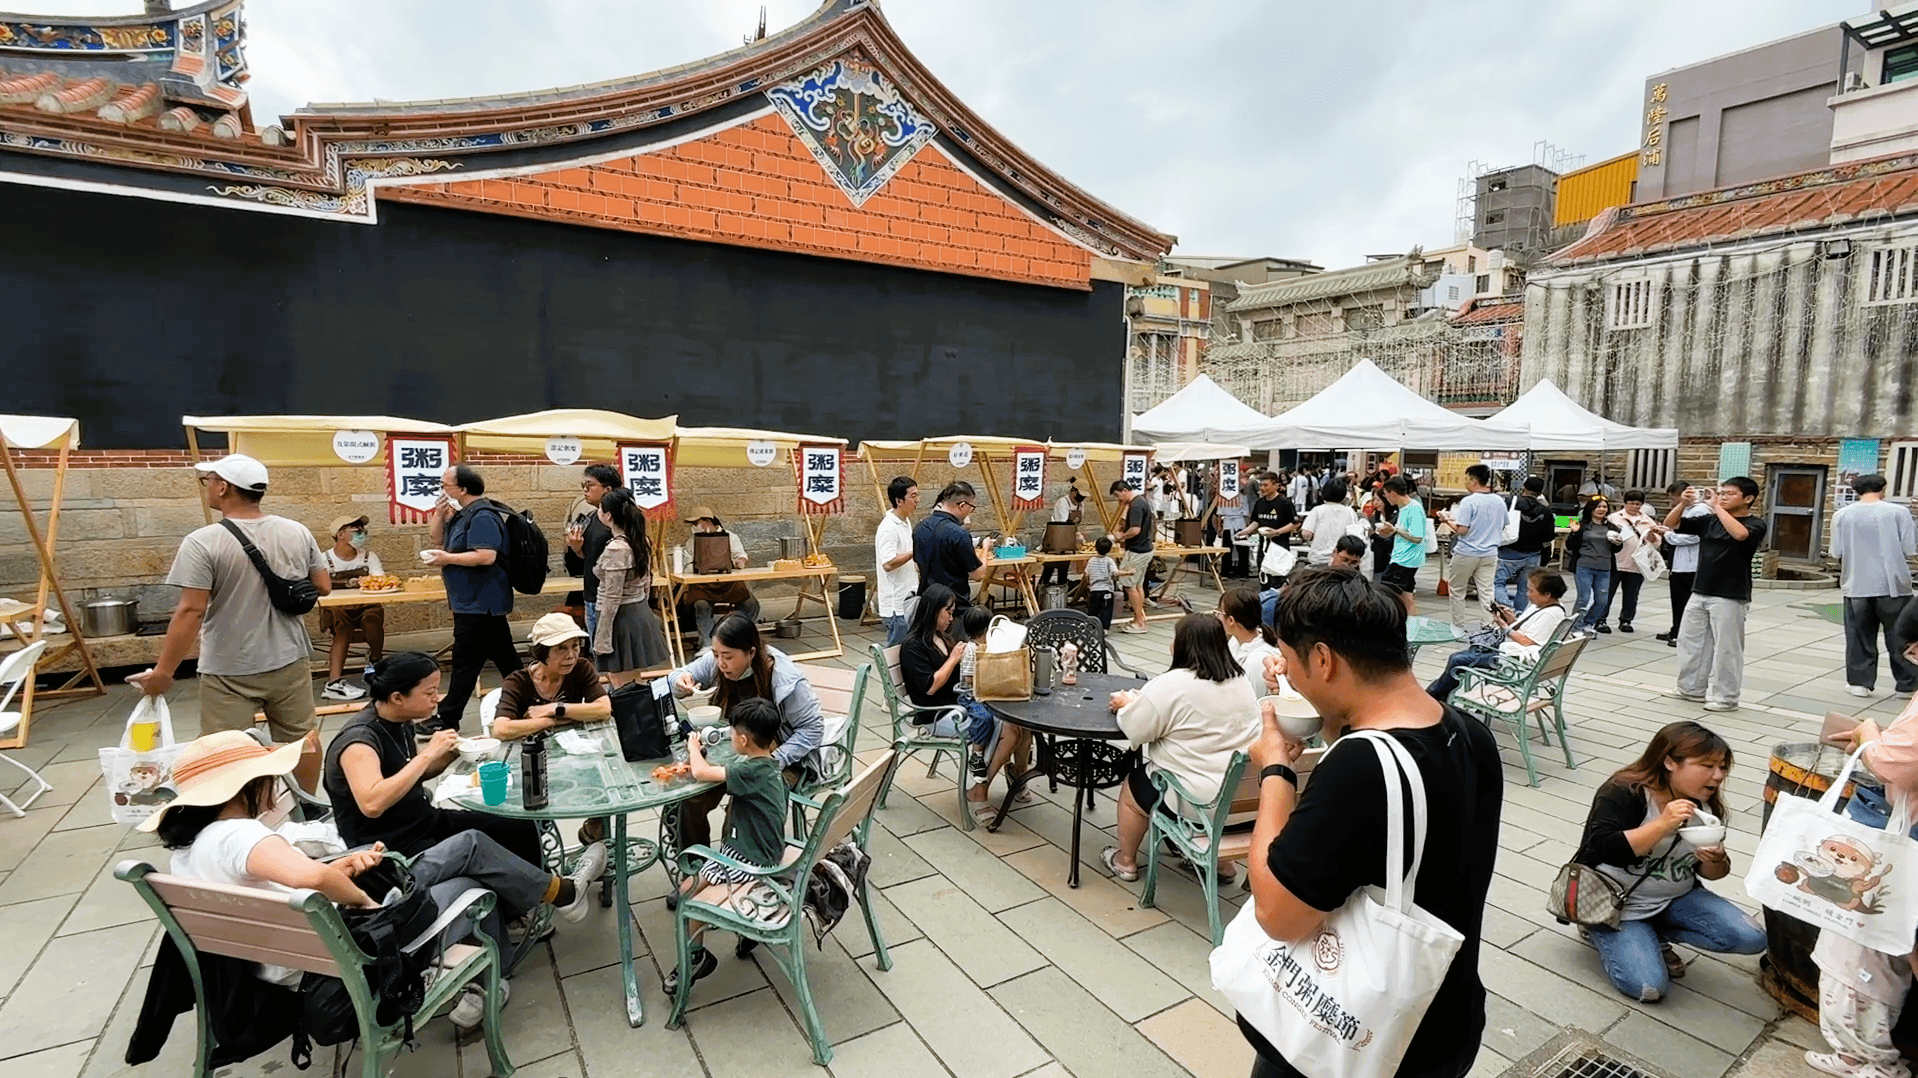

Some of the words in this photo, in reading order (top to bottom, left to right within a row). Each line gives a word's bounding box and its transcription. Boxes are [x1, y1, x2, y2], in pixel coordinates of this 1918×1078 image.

[400, 447, 442, 497] 粥糜
[628, 453, 662, 496] 粥糜
[806, 453, 835, 493] 粥糜
[1018, 457, 1040, 491] 粥糜
[1221, 462, 1237, 492] 粥糜
[1262, 945, 1361, 1041] 金門粥糜節
[1308, 1019, 1342, 1045] FESTIVAL
